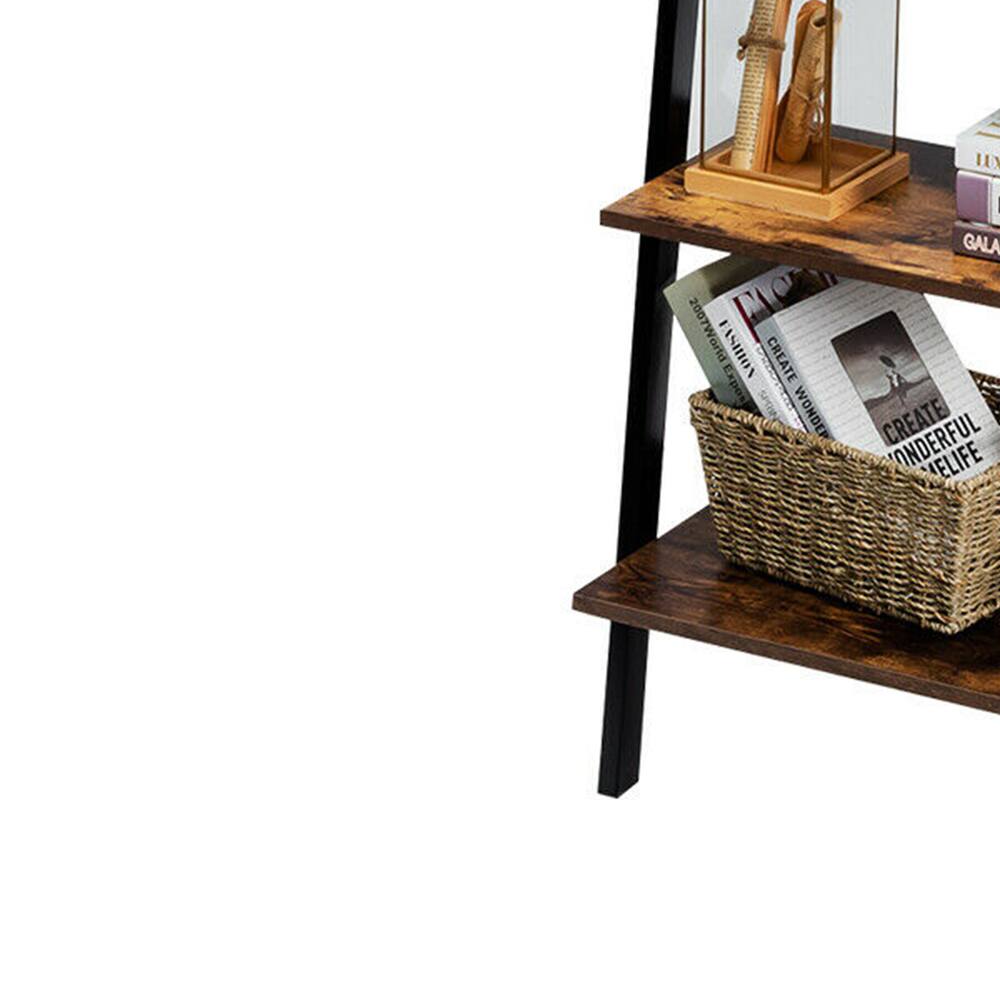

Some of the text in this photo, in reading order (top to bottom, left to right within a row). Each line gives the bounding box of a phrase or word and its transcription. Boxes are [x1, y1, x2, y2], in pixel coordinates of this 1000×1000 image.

[718, 319, 757, 379] FASHION
[767, 336, 798, 383] CREATE
[882, 398, 949, 445] CREATE
[887, 412, 982, 468] ONDERFUL
